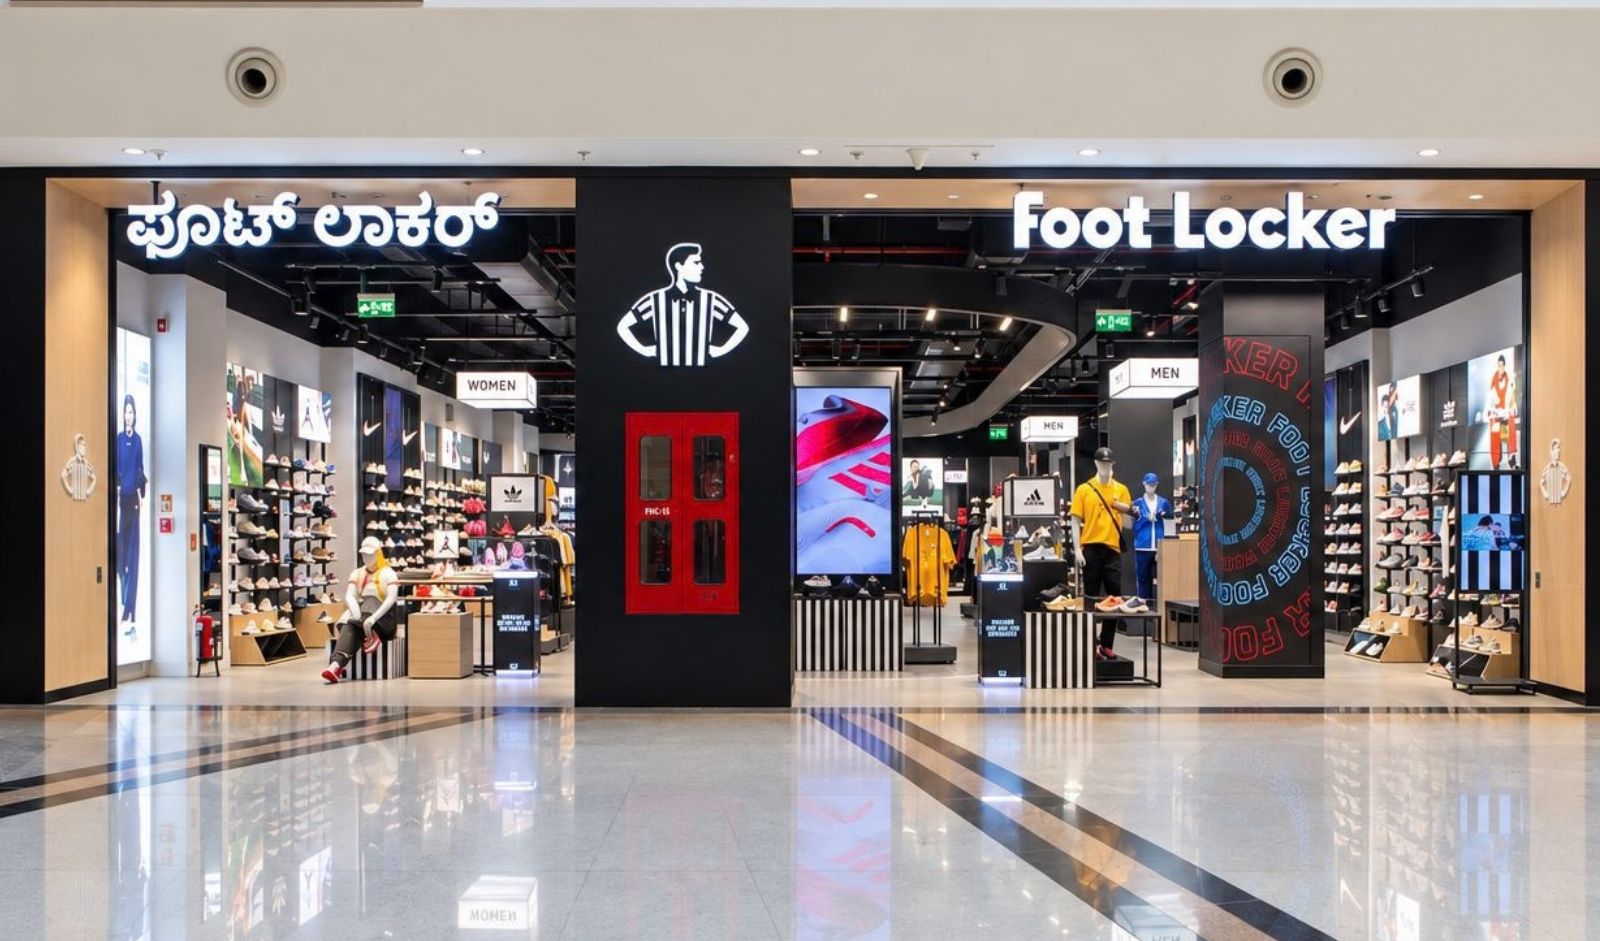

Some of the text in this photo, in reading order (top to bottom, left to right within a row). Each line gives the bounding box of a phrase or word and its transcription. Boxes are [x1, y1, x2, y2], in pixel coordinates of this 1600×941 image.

[126, 190, 500, 259] ಫೂಟ್ ಲಾಕರ್
[1013, 191, 1396, 250] Foot Locker
[1151, 367, 1180, 379] MEN
[467, 379, 516, 391] WOMEN
[1043, 421, 1064, 430] MEN
